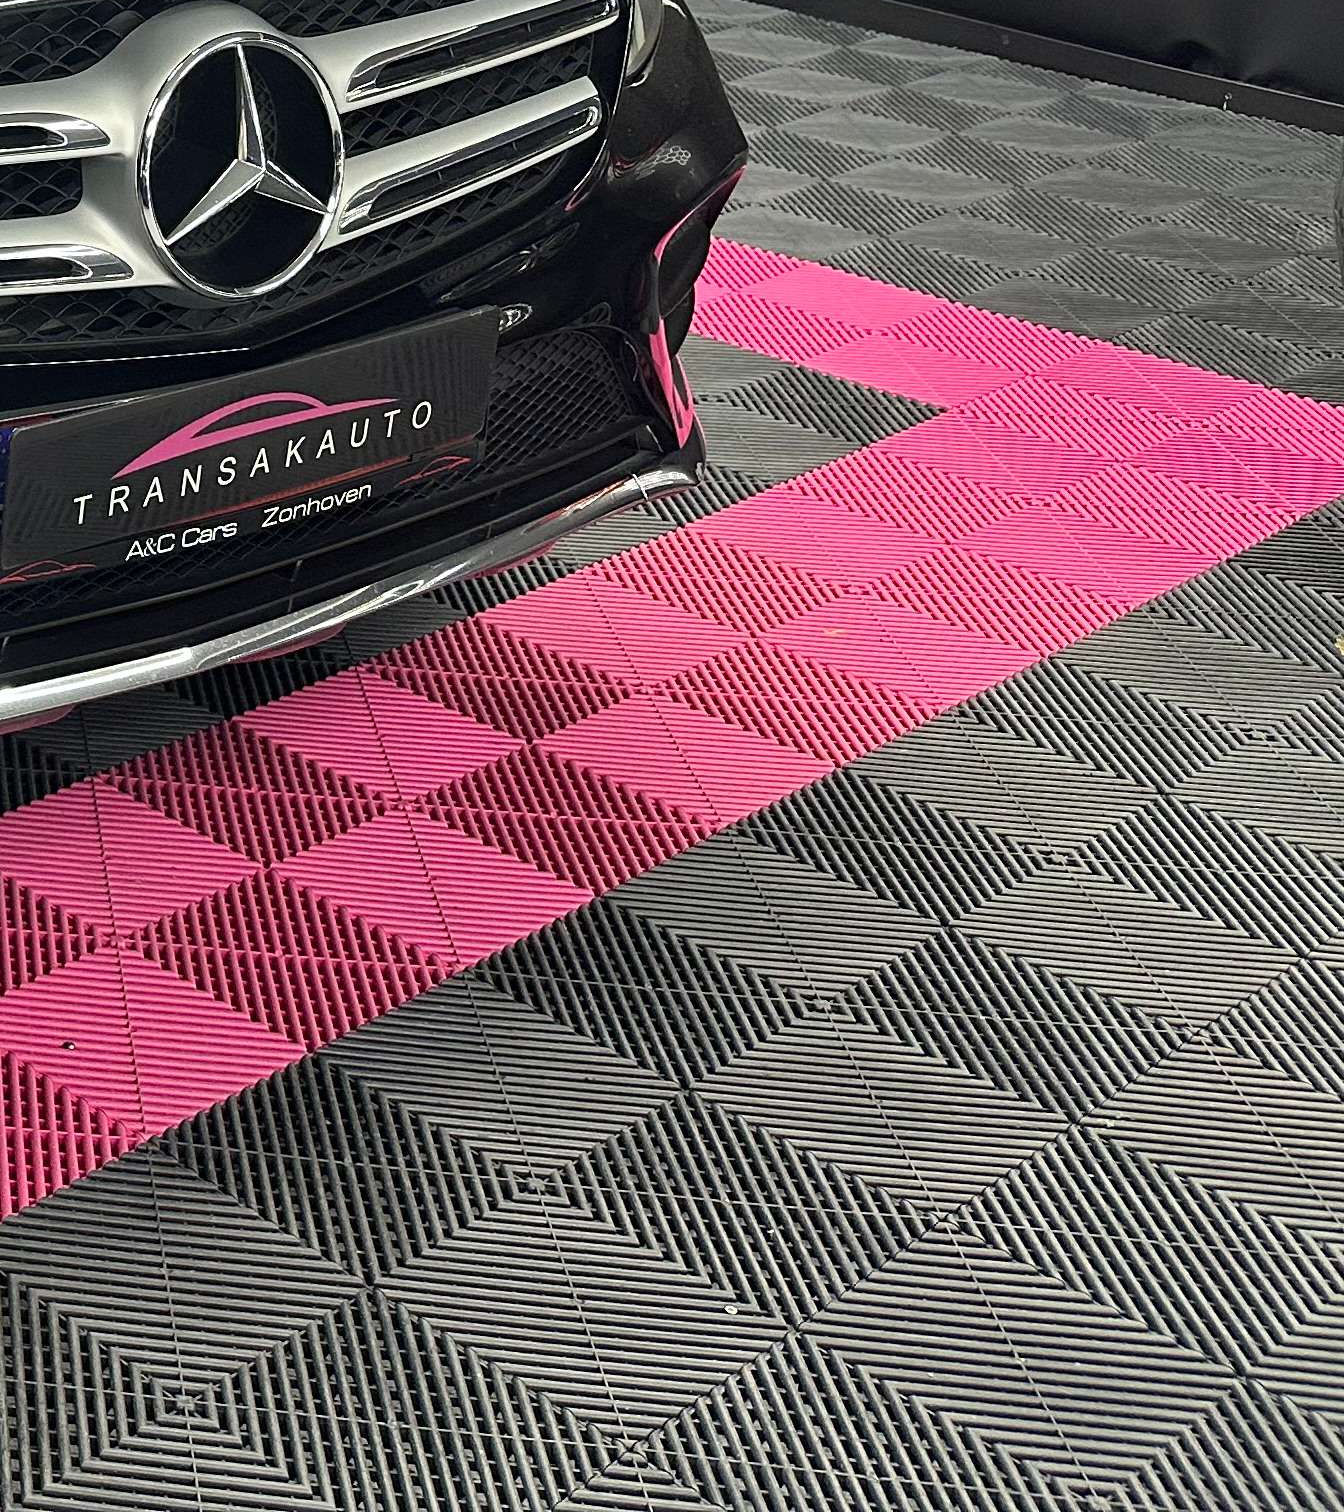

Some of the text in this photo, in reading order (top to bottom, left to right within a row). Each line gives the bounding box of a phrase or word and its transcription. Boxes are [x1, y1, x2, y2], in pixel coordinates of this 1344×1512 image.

[72, 399, 433, 525] TRANSAKAUTO
[124, 483, 372, 562] A&C Cars Zonhoven
